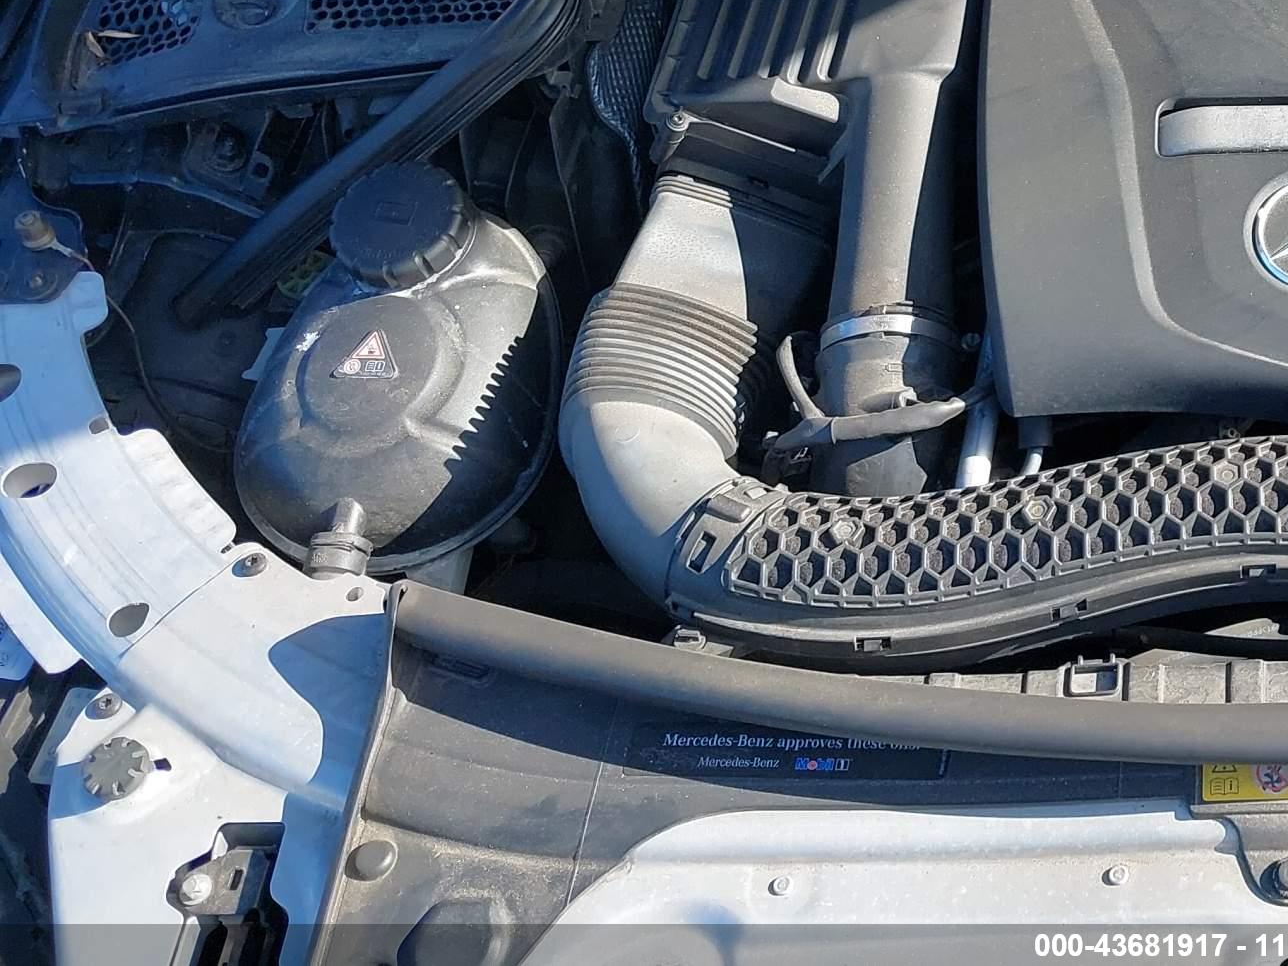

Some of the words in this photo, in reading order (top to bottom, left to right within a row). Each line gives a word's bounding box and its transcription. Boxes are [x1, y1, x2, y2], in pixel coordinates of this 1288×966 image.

[662, 733, 773, 748] Mercedes-Benz
[777, 737, 843, 751] approves
[697, 756, 780, 768] Mercedes-Benz
